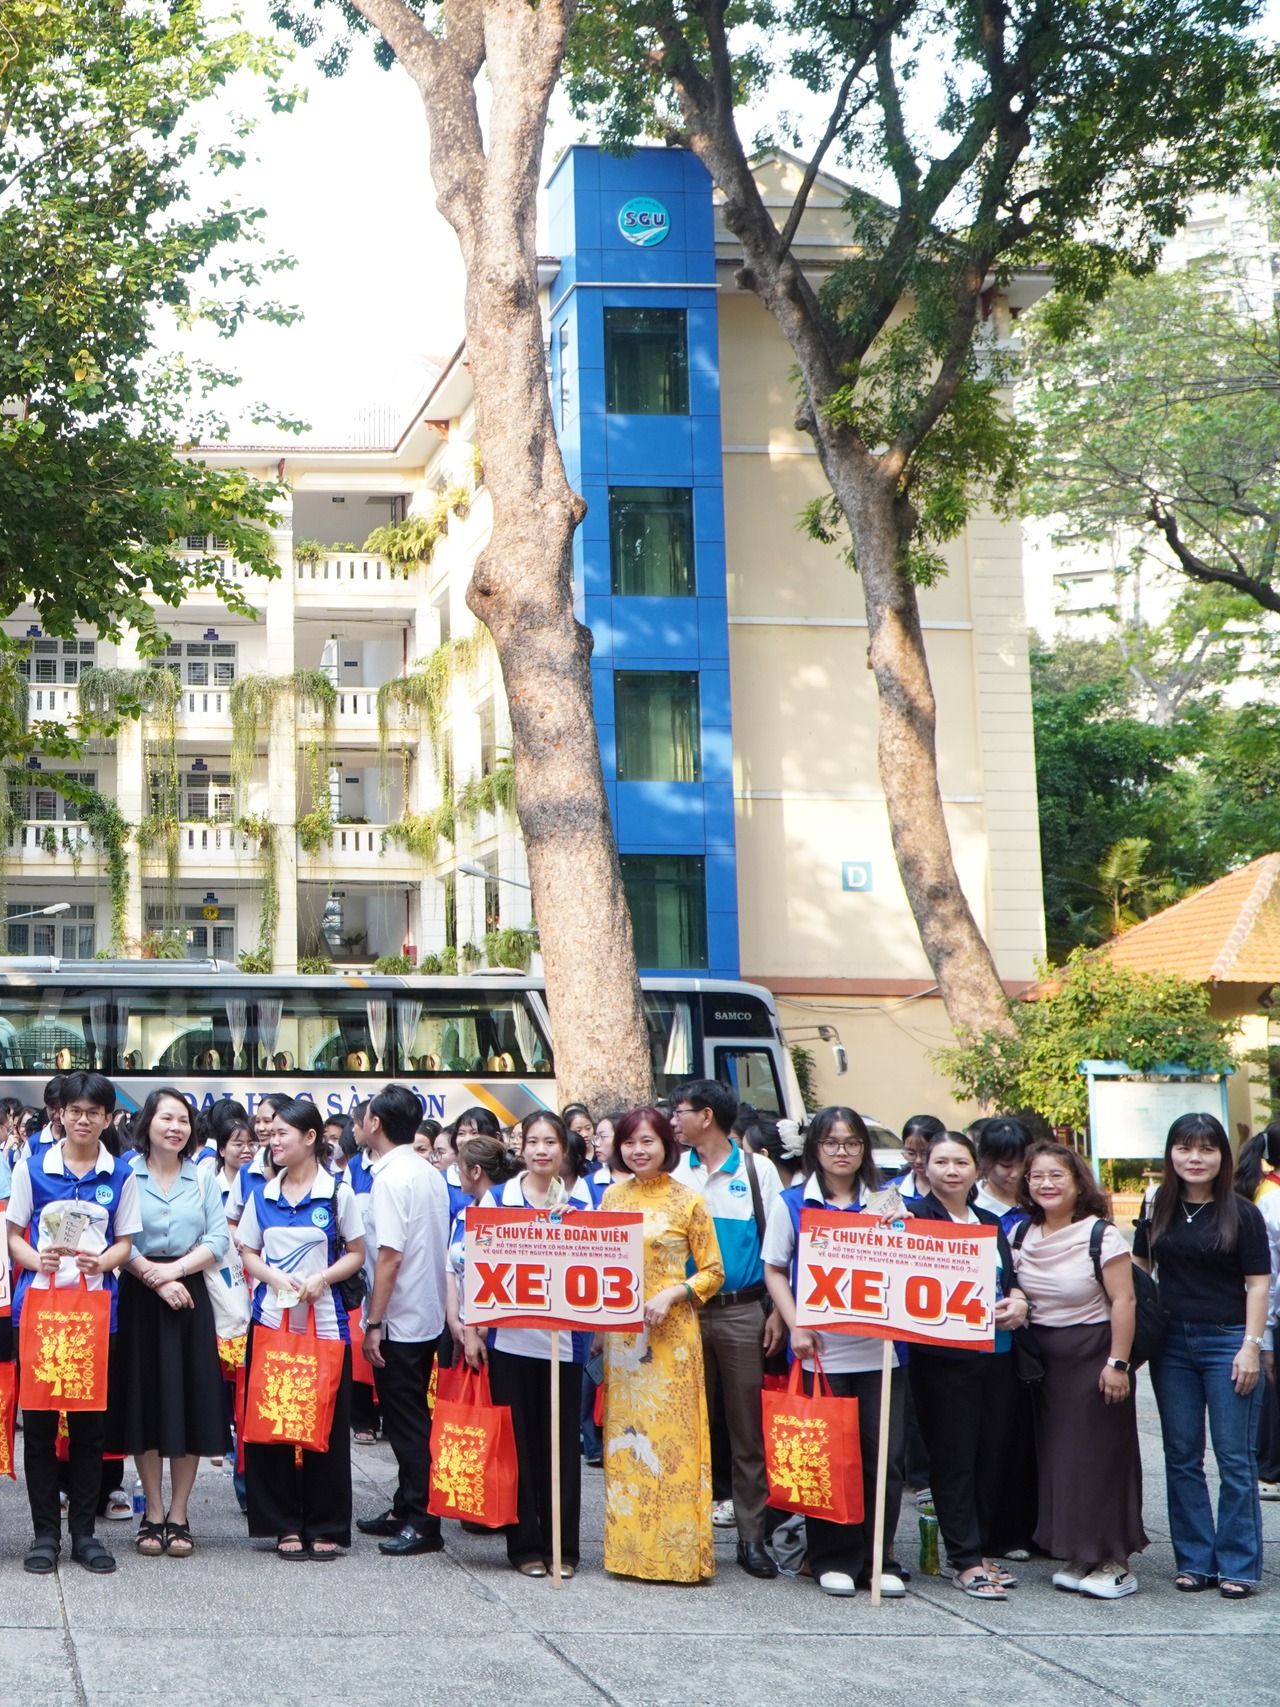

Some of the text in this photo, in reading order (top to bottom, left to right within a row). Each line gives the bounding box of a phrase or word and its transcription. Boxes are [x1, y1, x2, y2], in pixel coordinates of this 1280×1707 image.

[624, 211, 666, 227] SGU
[848, 866, 867, 887] D
[715, 1011, 752, 1021] SAMCO
[97, 1190, 112, 1198] SGU
[496, 1222, 542, 1239] CHUYẾN
[546, 1228, 560, 1240] XE
[564, 1226, 597, 1241] ĐOÀN
[601, 1228, 628, 1242] VIÊN
[833, 1228, 882, 1246] CHUYẾN
[887, 1236, 903, 1248] XE
[907, 1236, 943, 1252] ĐOÀN
[948, 1240, 979, 1256] VIÊN
[473, 1262, 638, 1312] XE 03
[805, 1264, 990, 1329] XE 04
